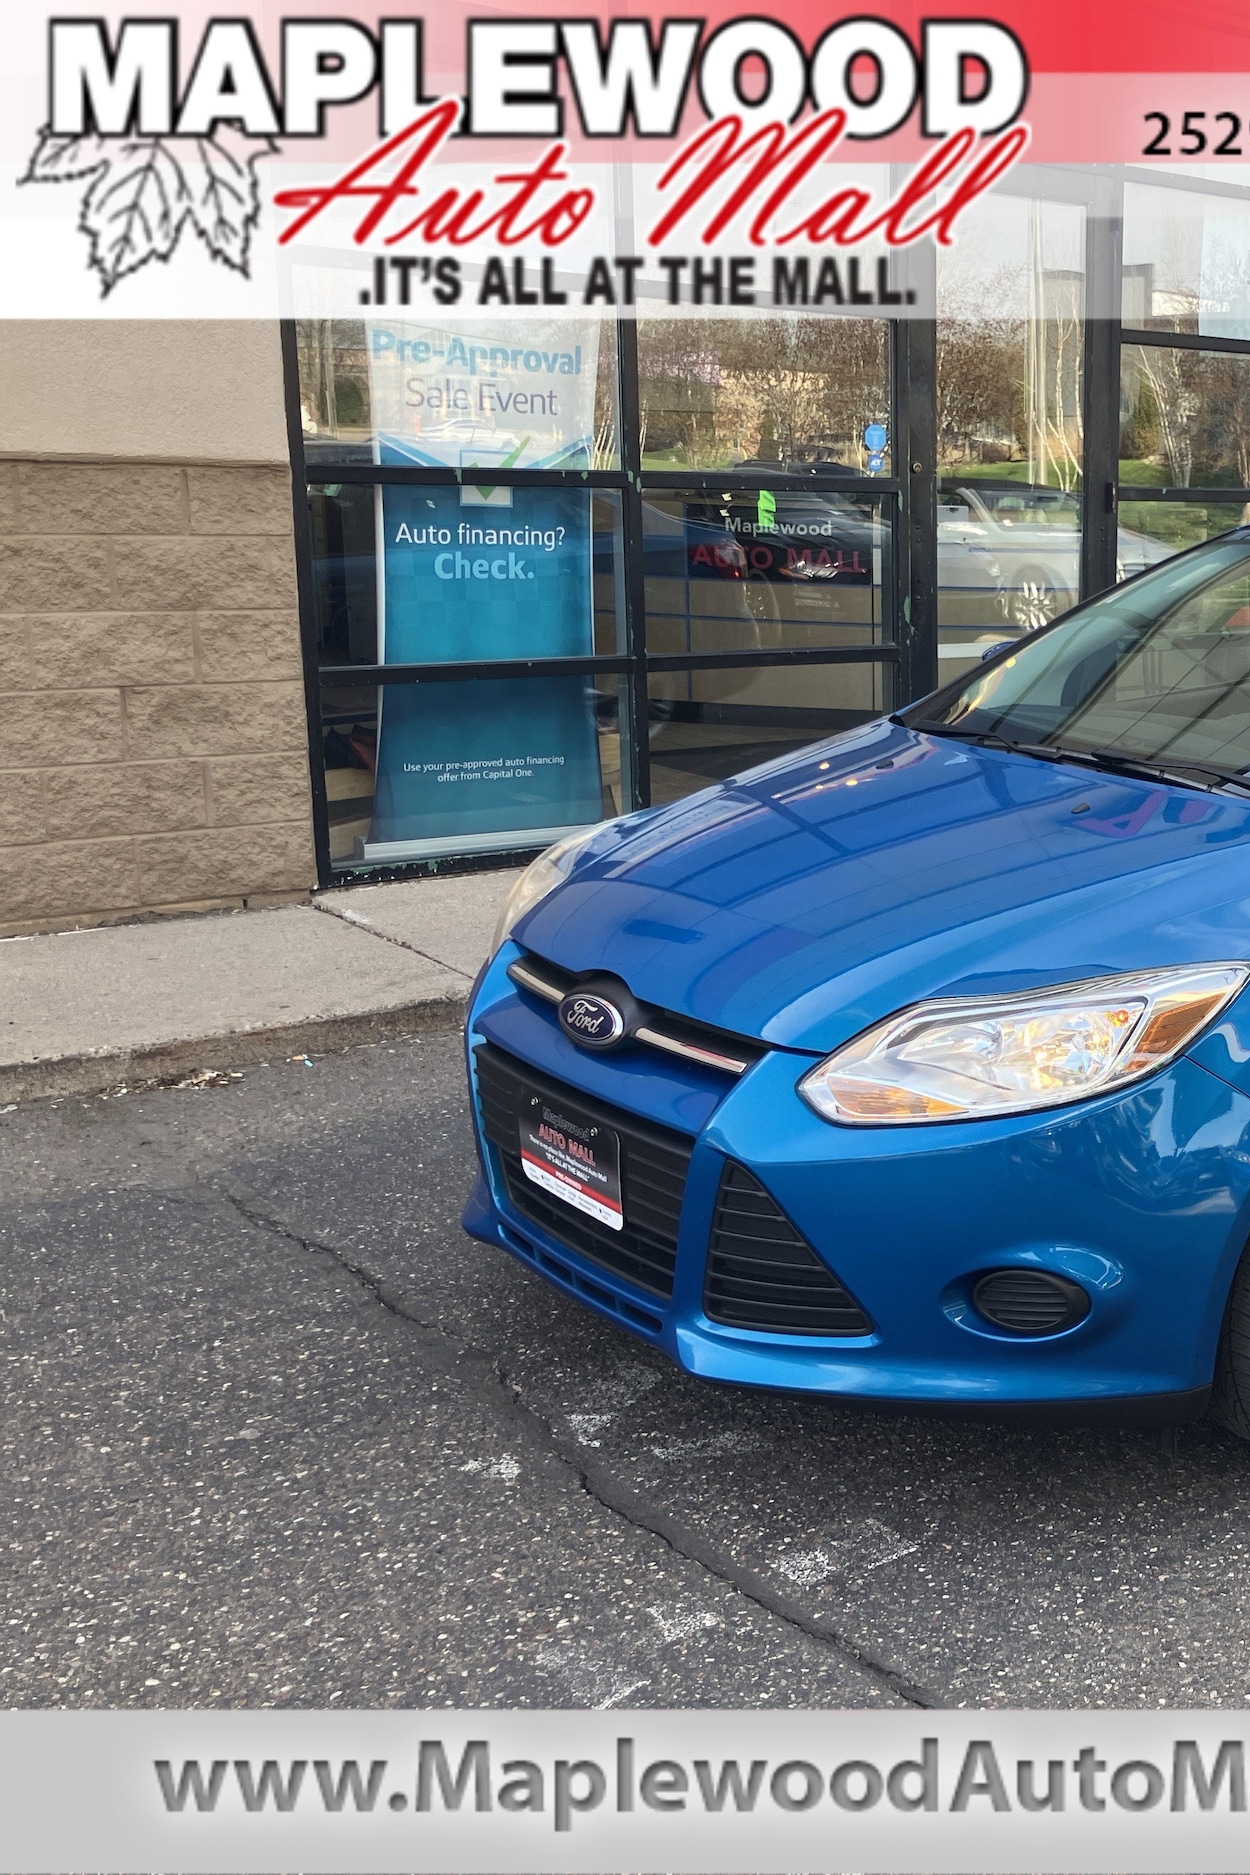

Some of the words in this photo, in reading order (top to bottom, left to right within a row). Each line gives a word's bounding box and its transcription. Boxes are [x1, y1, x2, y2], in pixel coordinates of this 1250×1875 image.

[371, 329, 582, 377] Pre-Approval
[405, 377, 469, 411] Sale
[479, 382, 558, 416] Event
[395, 523, 451, 544] Auto
[457, 523, 566, 552] financing?
[434, 551, 535, 580] Check.
[786, 548, 868, 574] MALL
[403, 762, 421, 772] Use
[423, 763, 444, 774] your
[445, 757, 503, 772] pre-approved
[505, 758, 525, 767] auto
[526, 755, 565, 766] financing
[437, 772, 458, 782] offer
[460, 771, 481, 782] from
[482, 768, 514, 781] Capital
[515, 768, 535, 778] One.
[566, 1000, 605, 1034] Ford
[538, 1123, 566, 1150] AUTO
[568, 1138, 597, 1167] MALL
